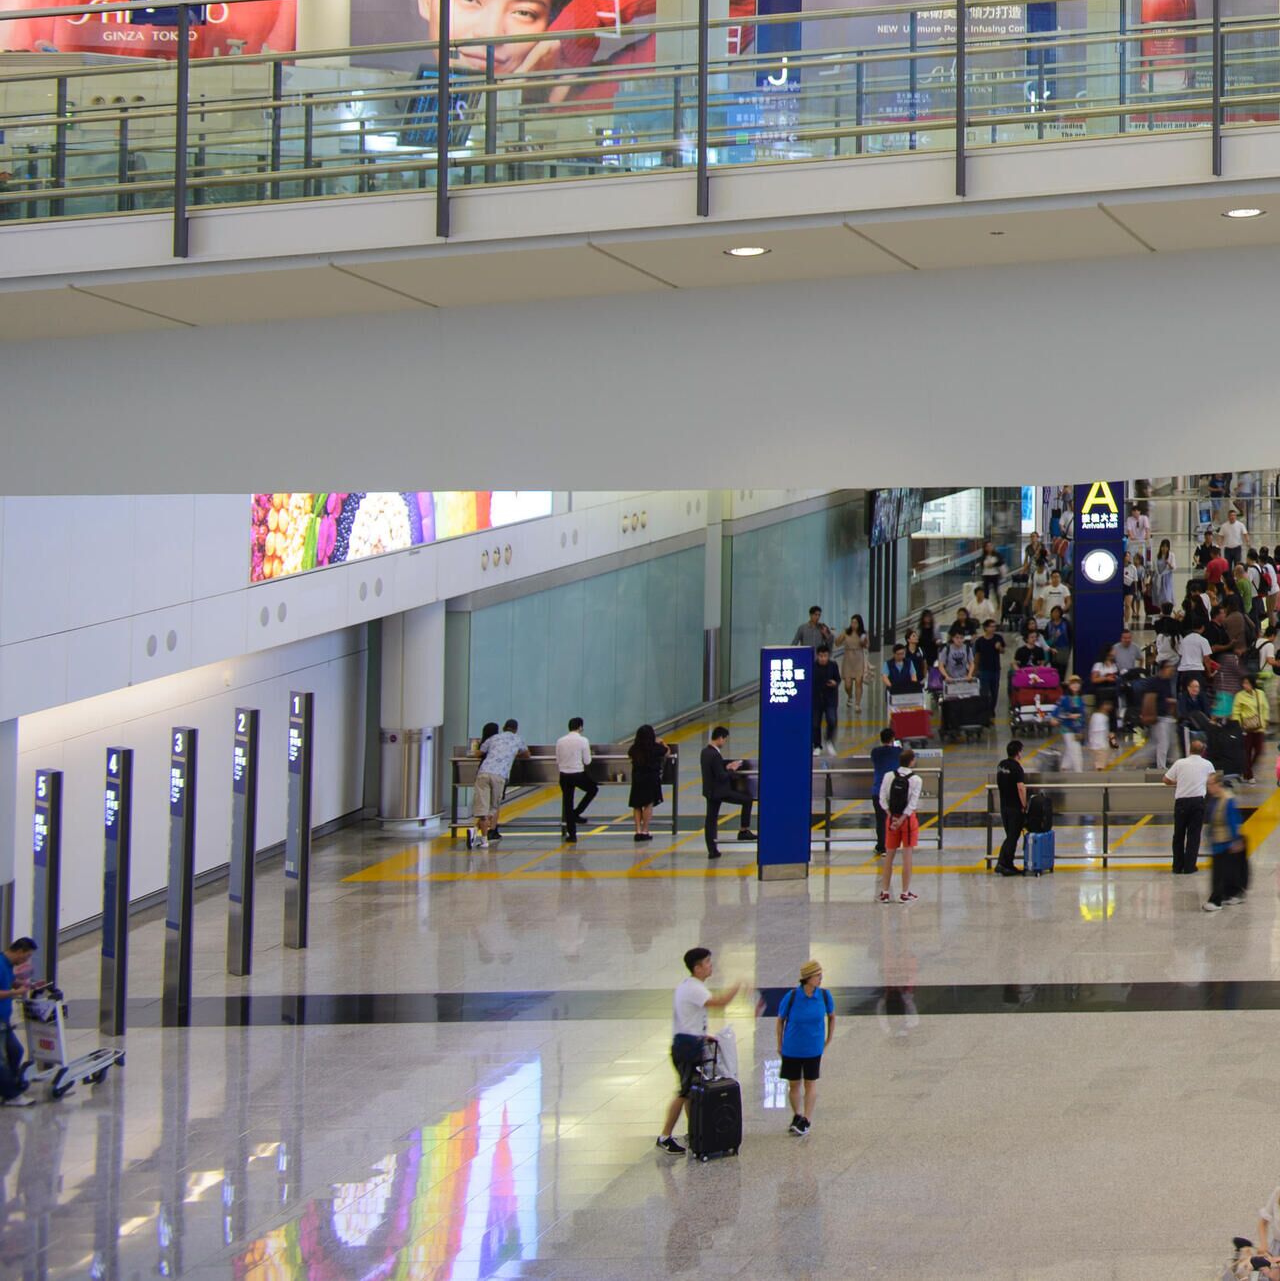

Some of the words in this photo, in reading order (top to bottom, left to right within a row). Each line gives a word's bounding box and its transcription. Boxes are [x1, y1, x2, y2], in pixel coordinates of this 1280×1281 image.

[103, 31, 144, 42] GINZA
[152, 31, 198, 42] TOKO
[877, 25, 898, 34] NEW
[970, 25, 1007, 35] Infusing
[1082, 481, 1119, 514] A
[770, 680, 795, 688] Group
[770, 688, 798, 696] Pick-up
[293, 696, 300, 714] 1
[770, 695, 789, 703] Area
[237, 713, 246, 732] 2
[175, 732, 183, 752] 3
[109, 753, 117, 773] 4
[37, 776, 46, 797] 5
